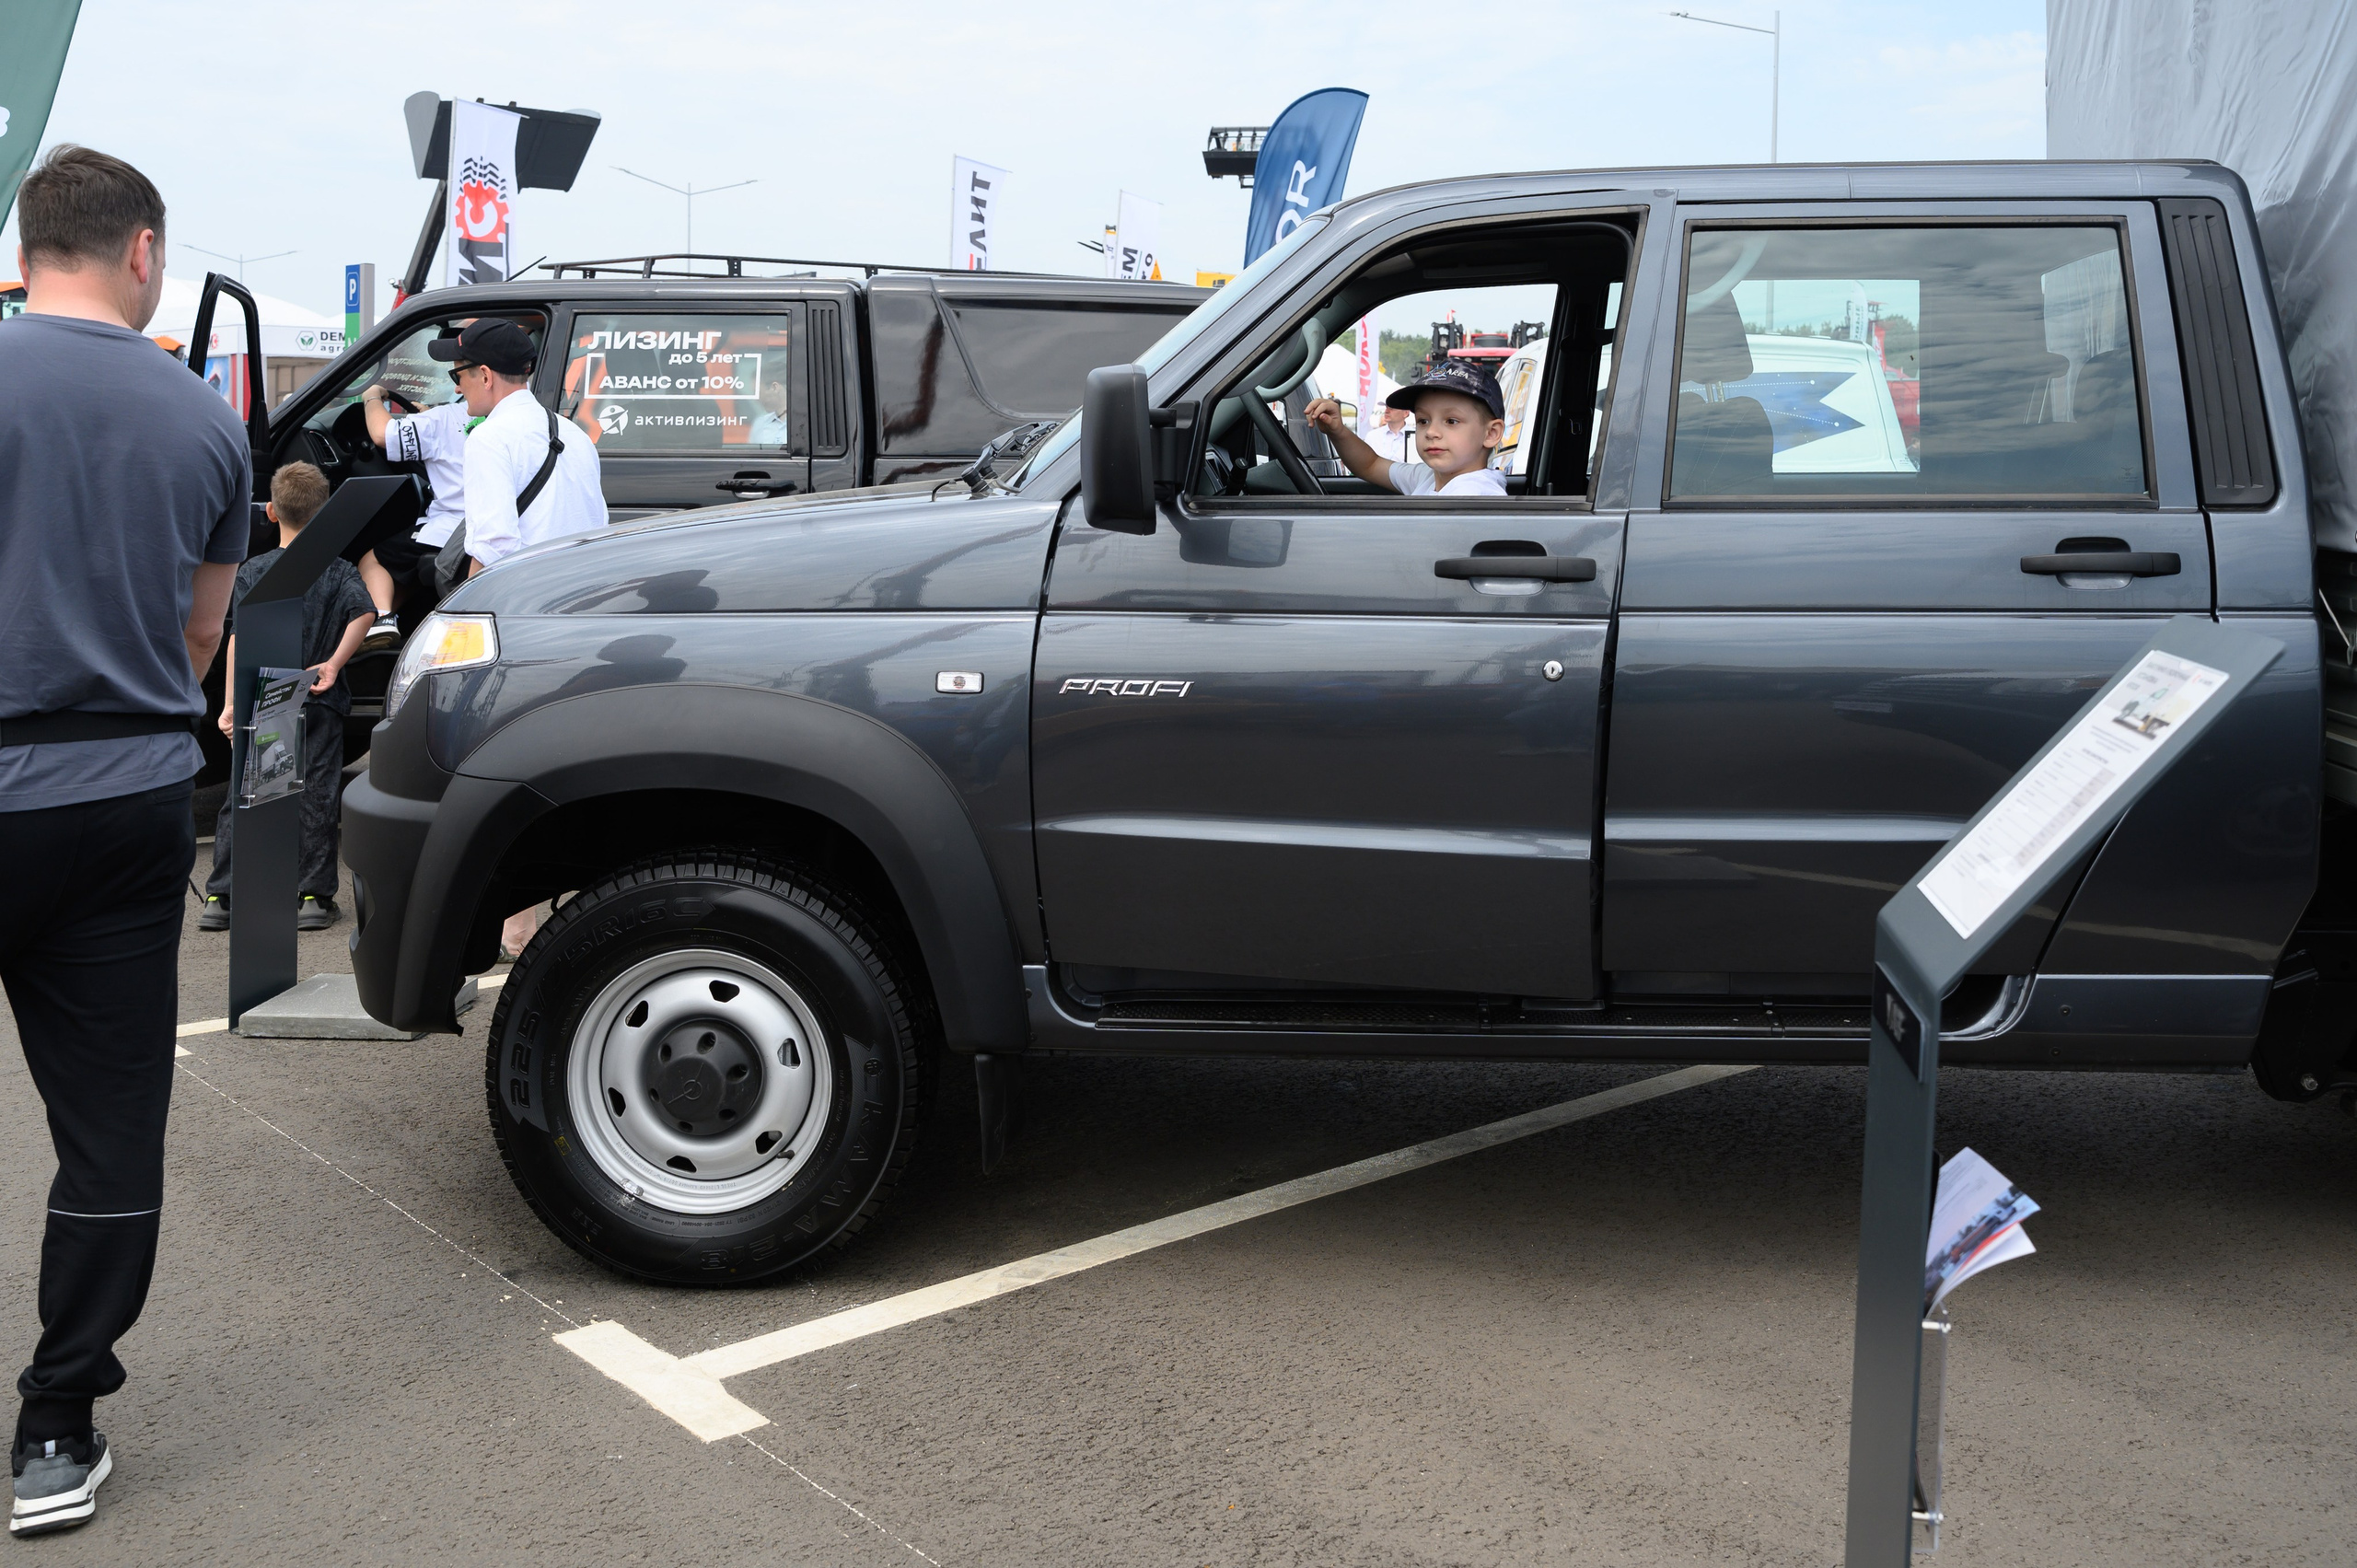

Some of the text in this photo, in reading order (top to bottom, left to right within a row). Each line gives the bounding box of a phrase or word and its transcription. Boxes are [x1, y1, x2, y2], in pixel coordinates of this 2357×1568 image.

[348, 278, 357, 301] P
[587, 331, 722, 350] ЛИЗИНГ
[668, 353, 743, 365] до 5 лет
[599, 376, 745, 389] АВАНС от 10%
[634, 415, 748, 427] активлизинг
[1059, 678, 1195, 698] PROFI
